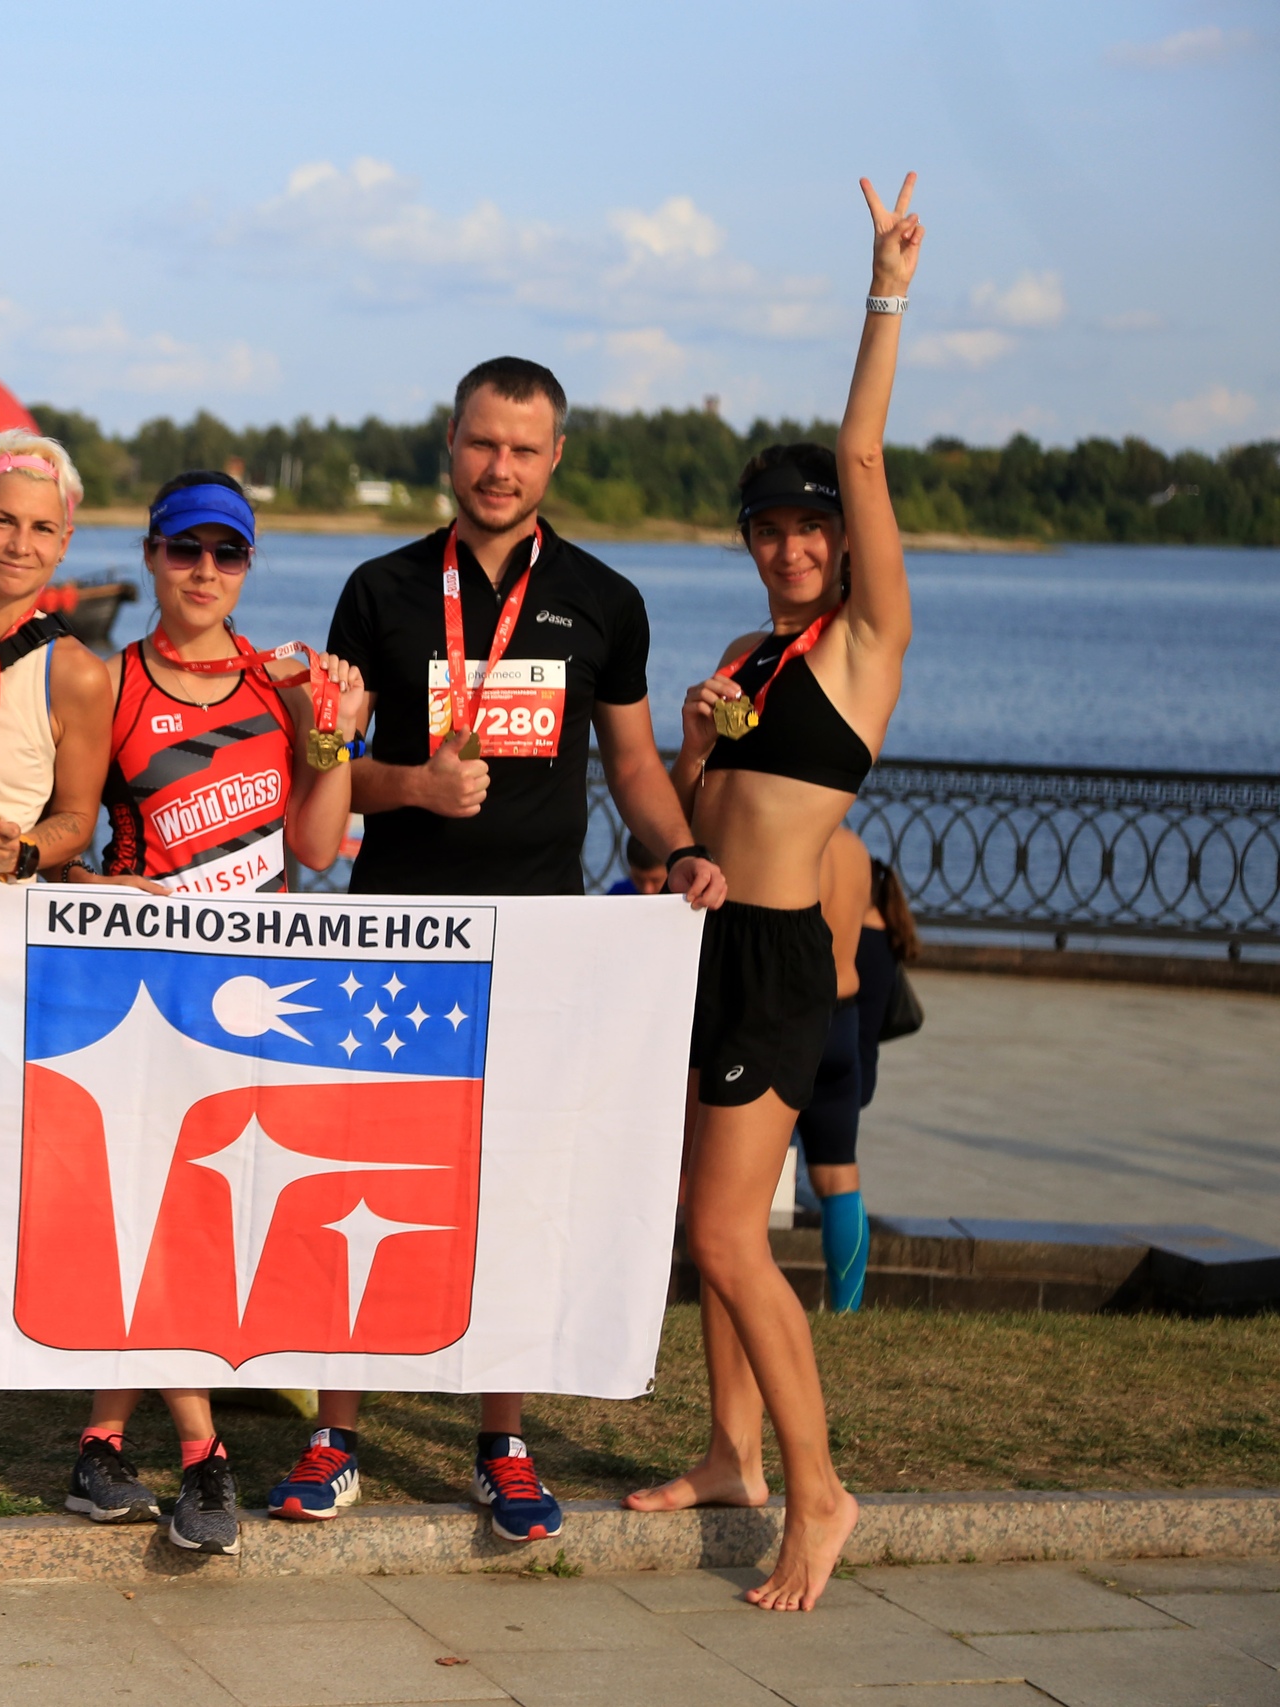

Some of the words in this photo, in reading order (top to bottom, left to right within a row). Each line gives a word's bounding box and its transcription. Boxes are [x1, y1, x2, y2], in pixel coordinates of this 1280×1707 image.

[447, 572, 457, 592] 2018
[548, 613, 573, 628] asics
[278, 642, 300, 657] 2018
[531, 665, 545, 682] B
[156, 785, 222, 843] World
[221, 774, 278, 817] Class
[48, 900, 472, 949] КРАСНОЗНАМЕНСК
